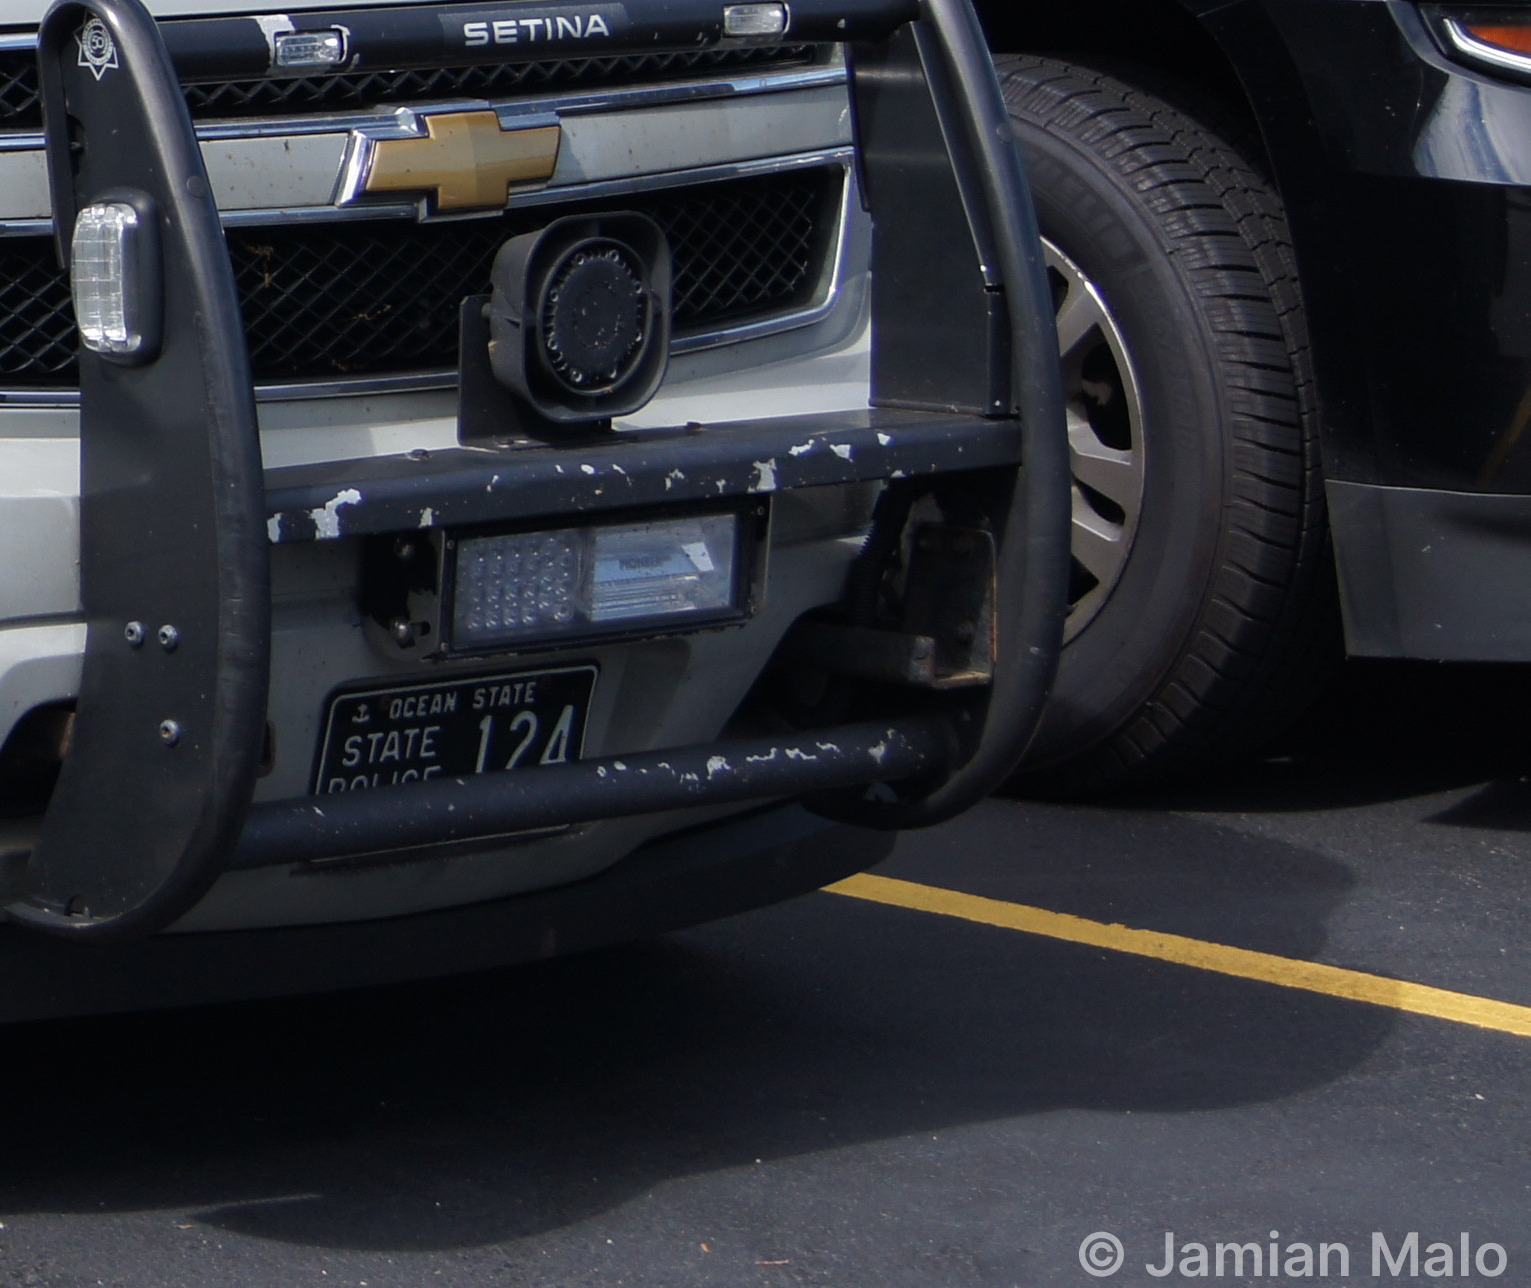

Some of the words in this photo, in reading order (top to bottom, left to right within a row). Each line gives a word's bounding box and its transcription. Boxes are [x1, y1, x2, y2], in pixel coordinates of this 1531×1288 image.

[463, 13, 610, 47] SETINA
[388, 691, 458, 720] OCEAN
[472, 681, 538, 710] STATE
[341, 725, 444, 768] STATE
